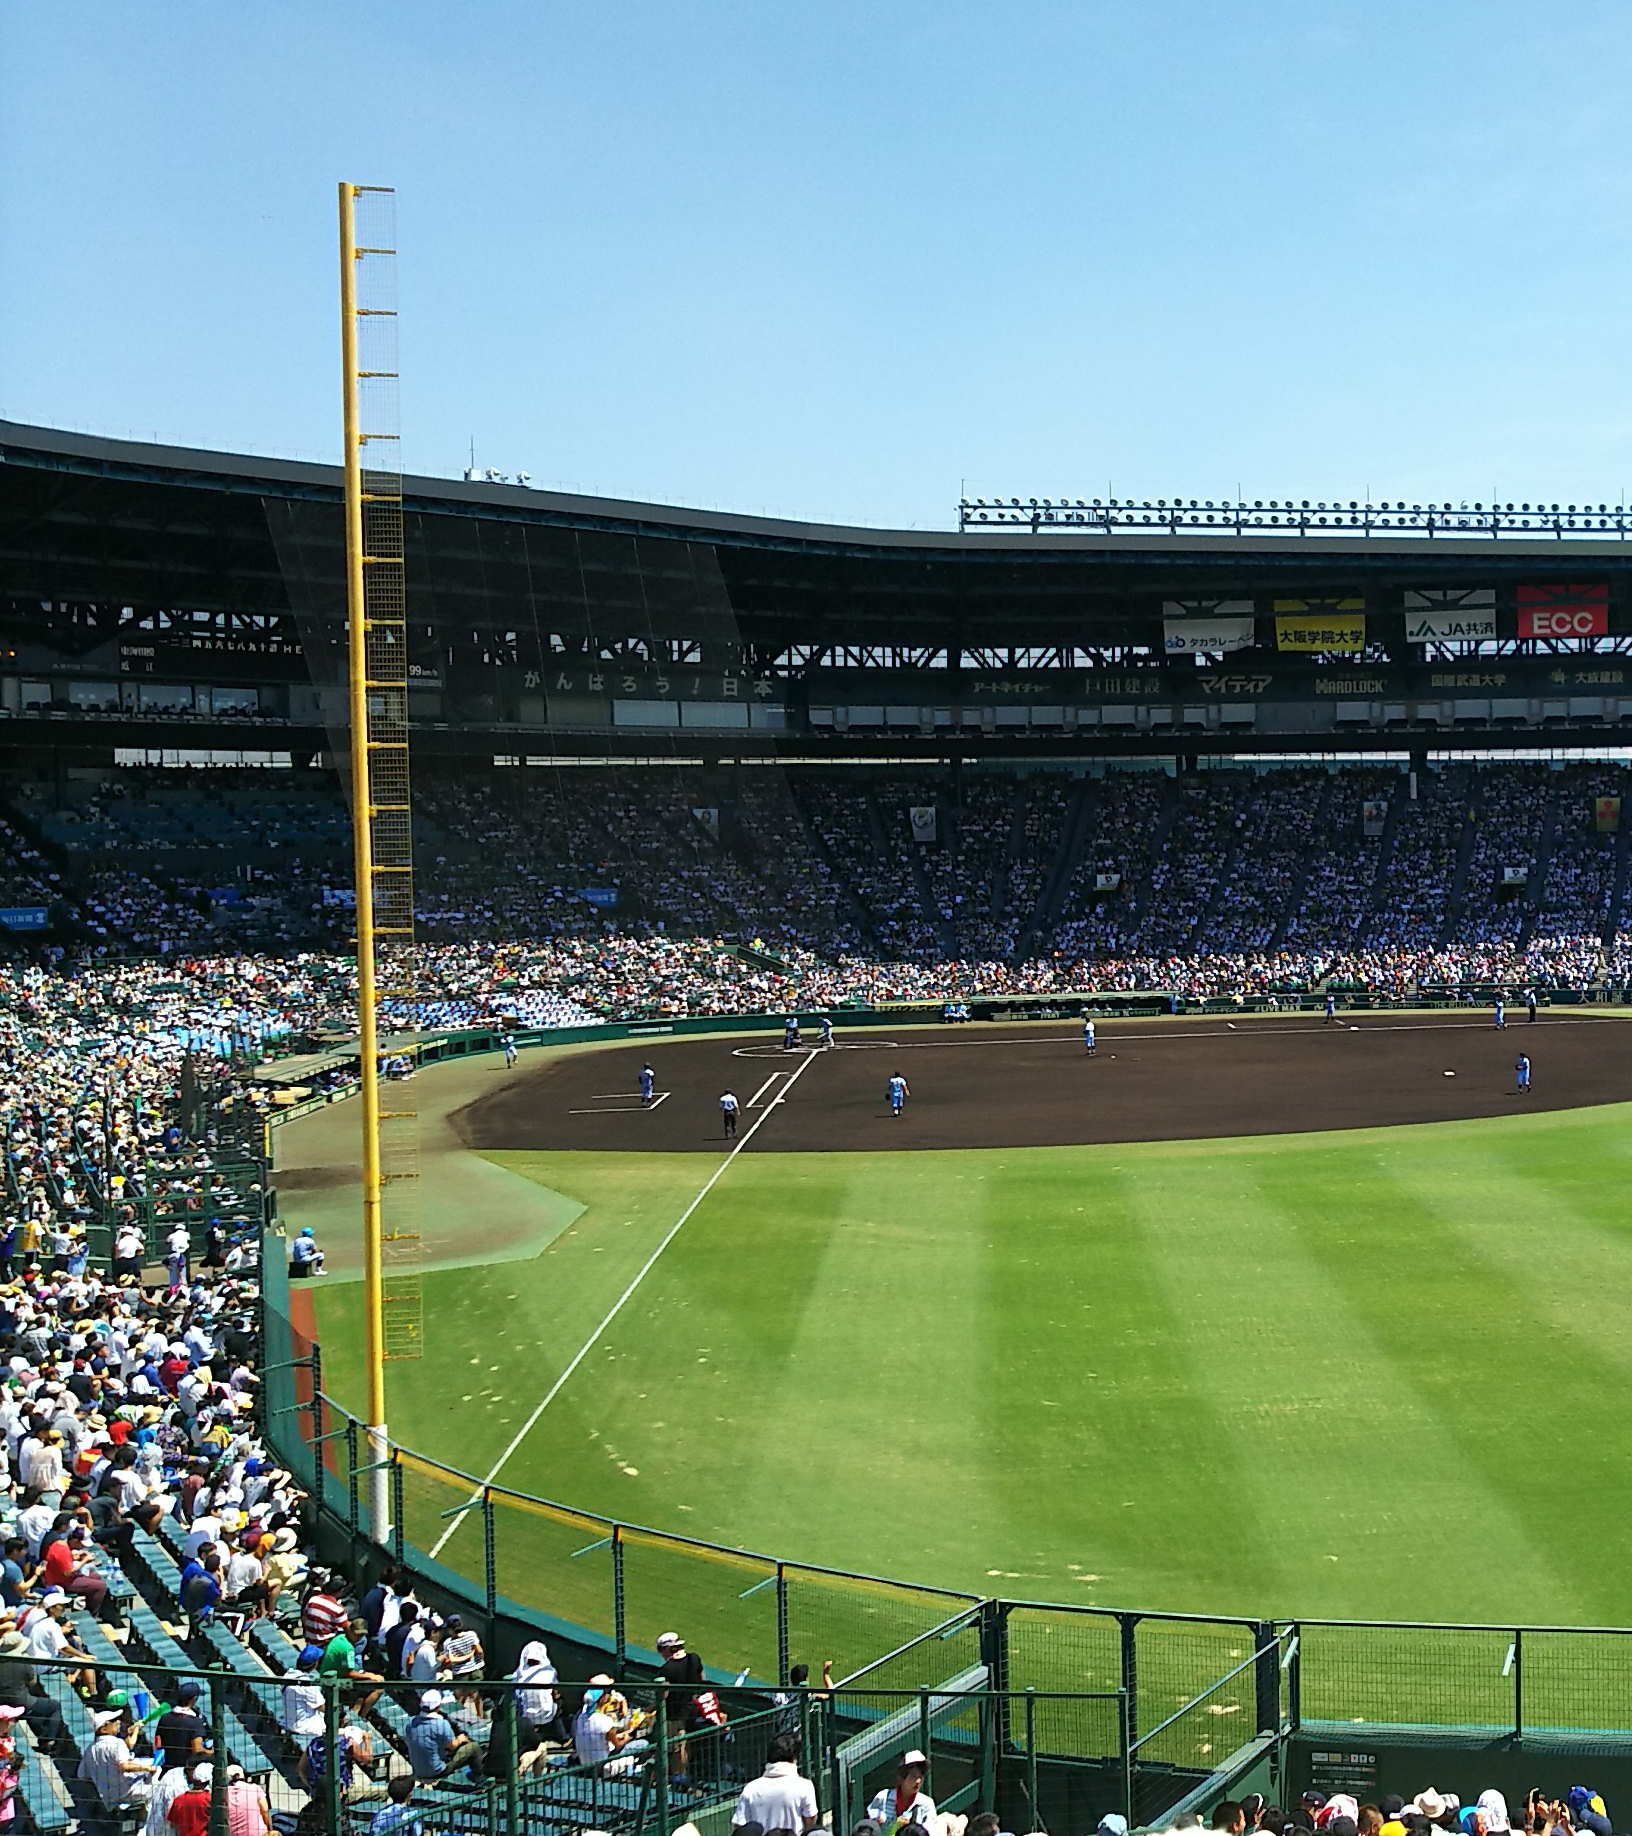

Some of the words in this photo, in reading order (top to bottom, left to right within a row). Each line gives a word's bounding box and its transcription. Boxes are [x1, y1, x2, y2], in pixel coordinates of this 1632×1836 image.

[1440, 621, 1494, 636] JA共済
[1532, 611, 1594, 634] ECC
[1189, 634, 1254, 647] タカラレーベン
[1280, 630, 1363, 644] 大阪学院大学
[1197, 675, 1273, 693] マイティア
[1431, 674, 1506, 687] 国際武道大学
